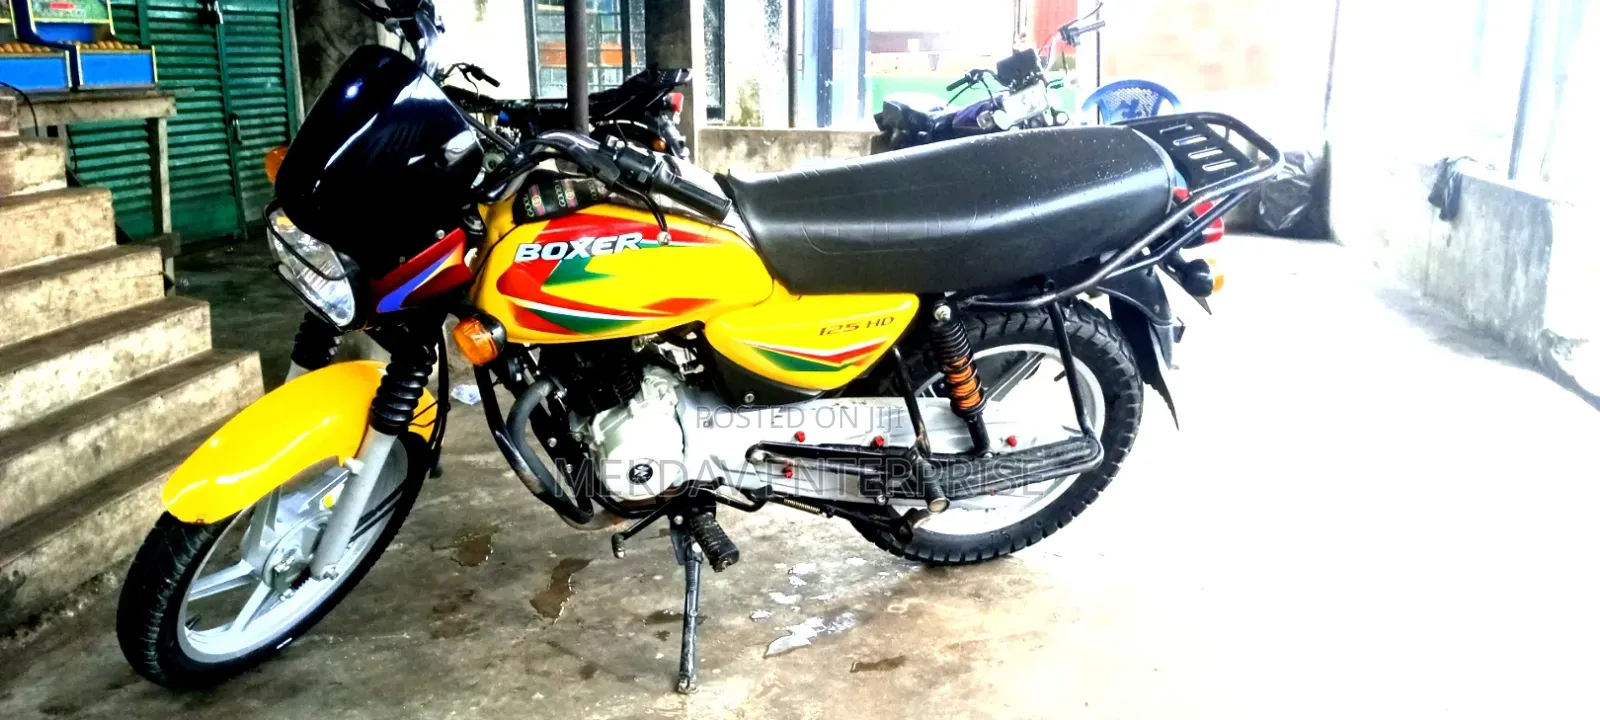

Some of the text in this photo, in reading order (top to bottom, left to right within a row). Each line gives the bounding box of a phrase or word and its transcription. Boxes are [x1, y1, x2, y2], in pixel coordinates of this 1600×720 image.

[514, 232, 643, 263] BOXER
[818, 316, 894, 336] 125 HD
